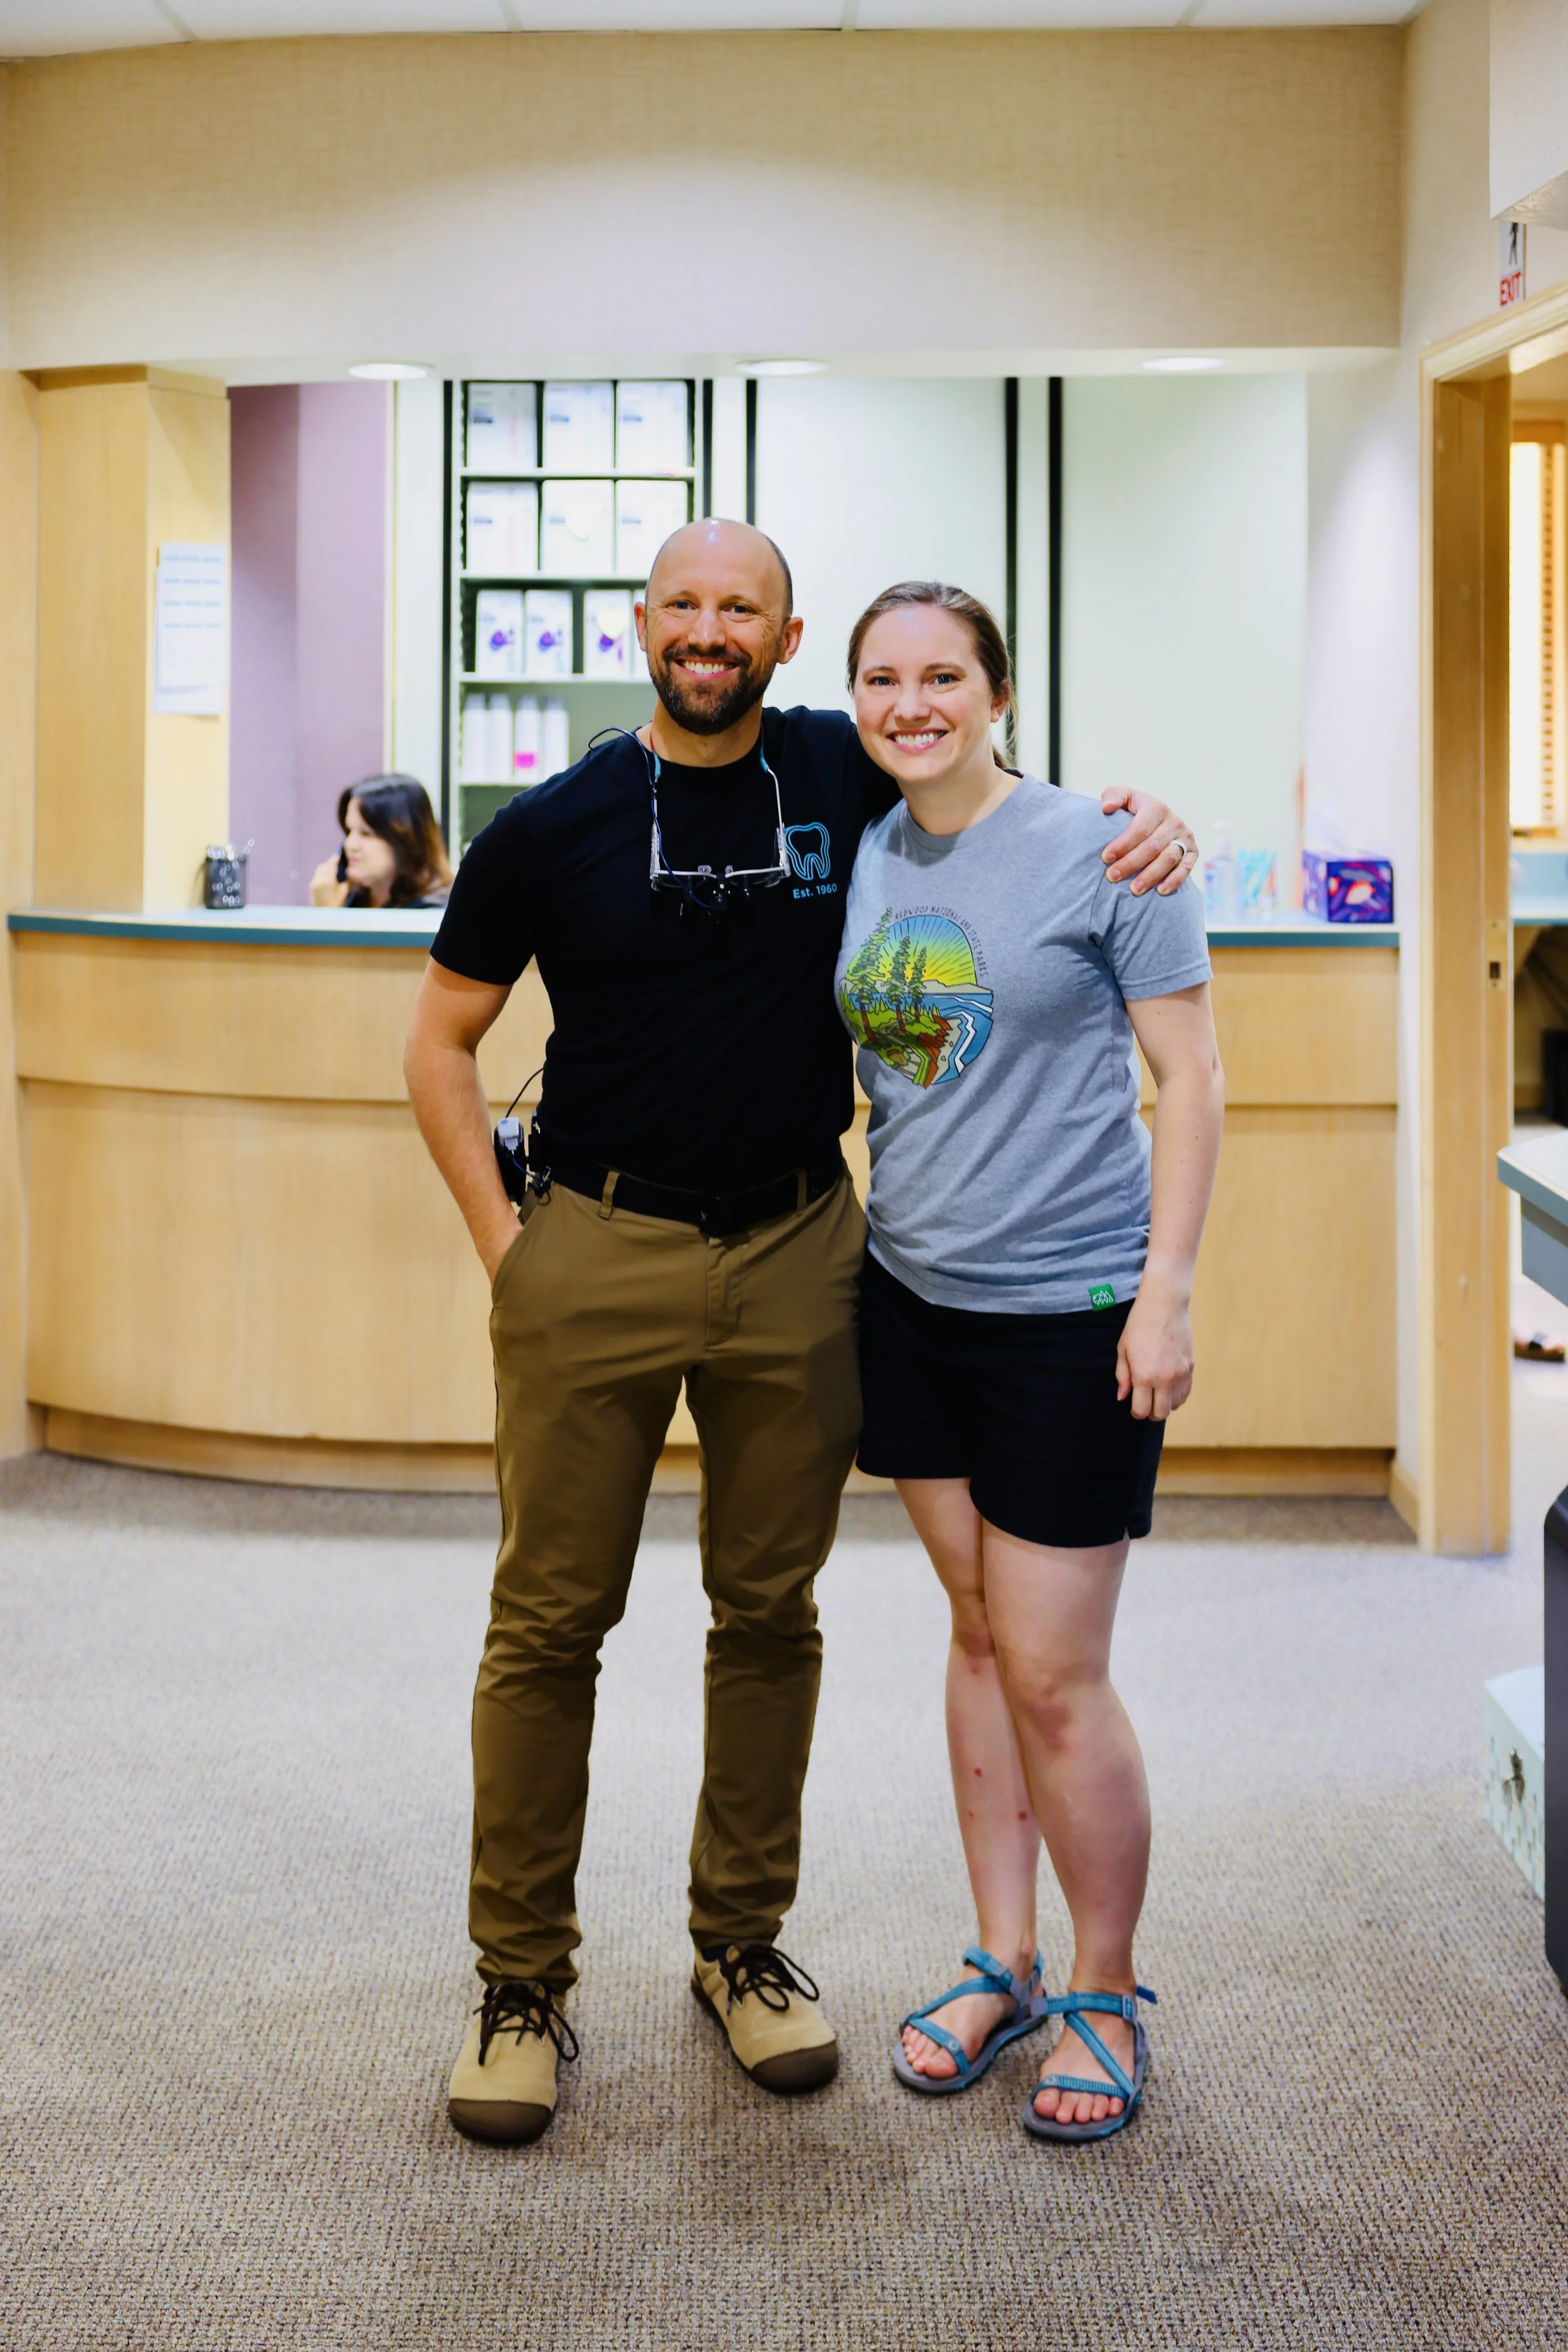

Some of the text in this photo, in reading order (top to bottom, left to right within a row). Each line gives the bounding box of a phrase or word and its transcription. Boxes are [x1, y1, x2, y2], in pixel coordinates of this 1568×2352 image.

[1500, 271, 1521, 306] EXIT
[793, 883, 837, 899] Est. 1960
[895, 905, 988, 977] REDWOOD NATIONAL AND STATE PARKS
